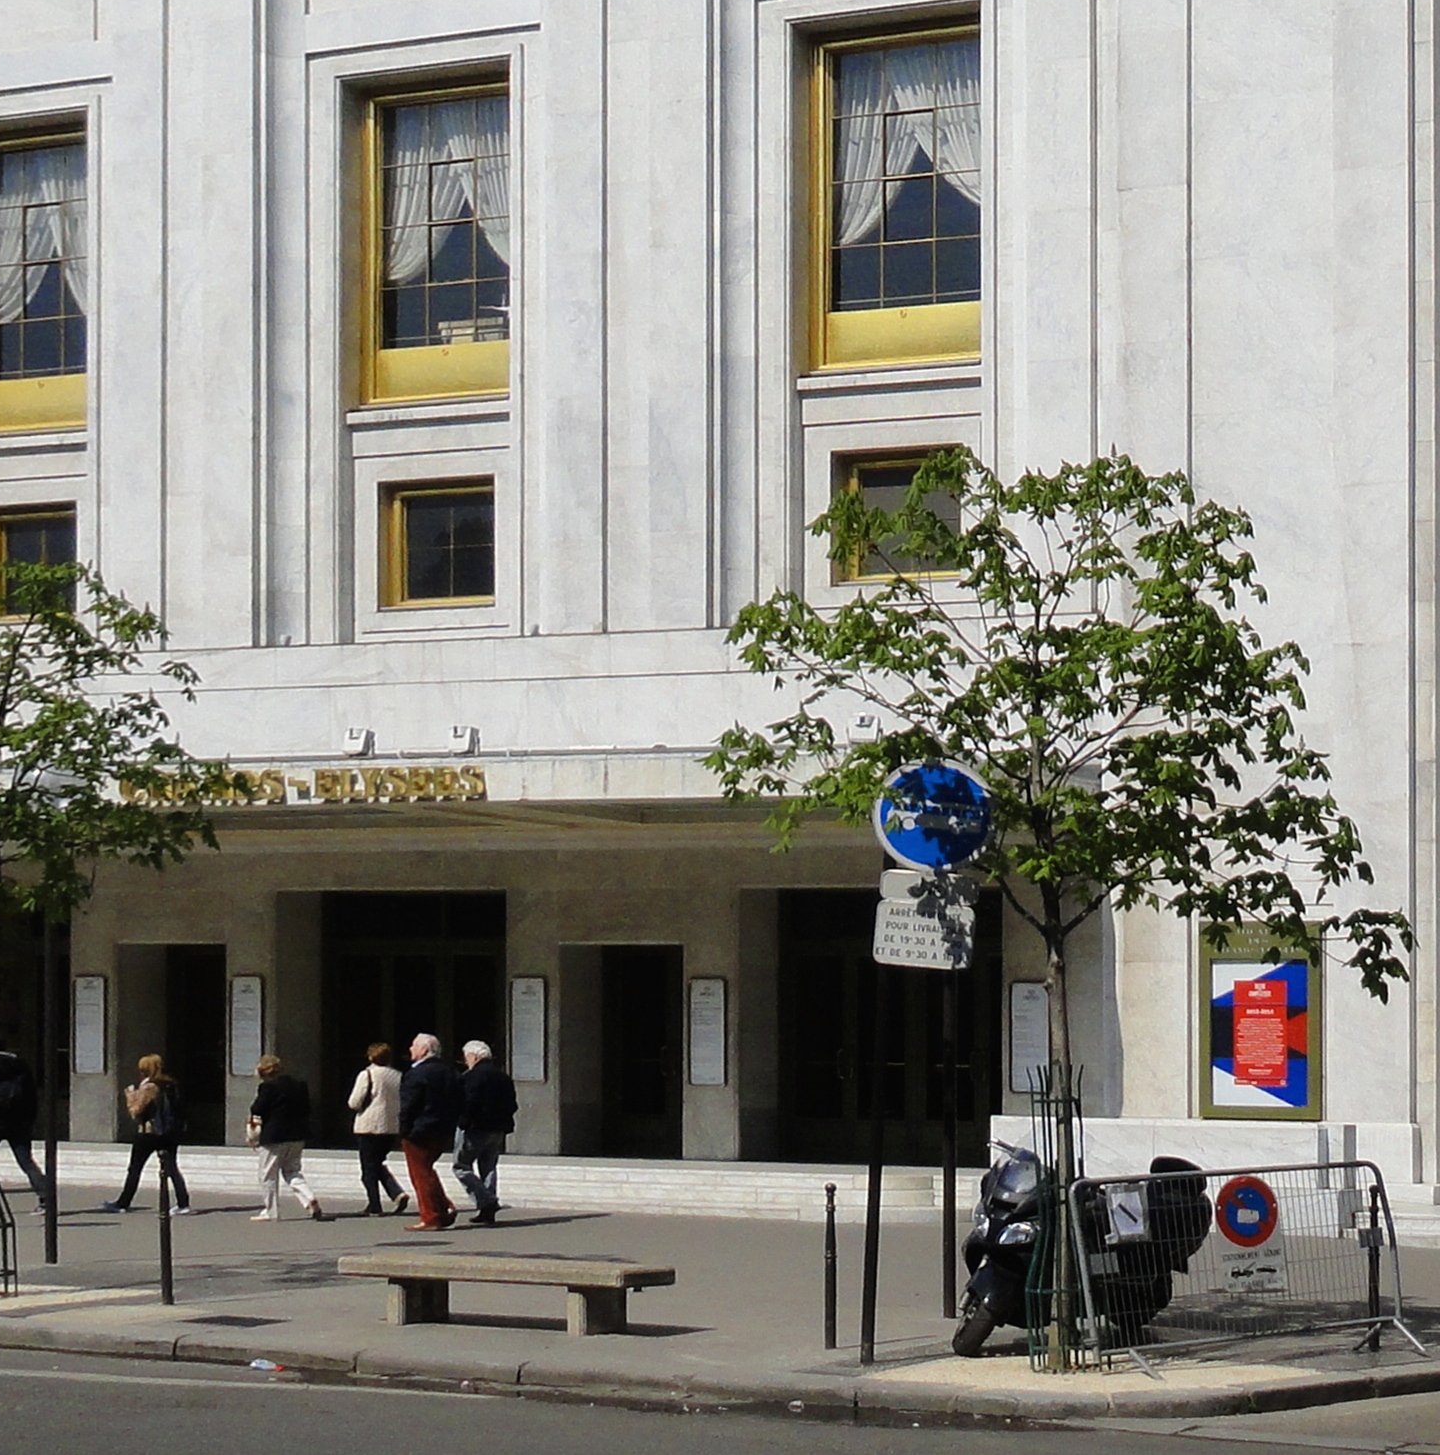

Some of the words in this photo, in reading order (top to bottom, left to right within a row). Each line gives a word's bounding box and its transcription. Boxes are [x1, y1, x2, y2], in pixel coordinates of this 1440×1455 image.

[885, 921, 909, 930] POUR
[883, 934, 895, 943] DE
[875, 947, 886, 955] ET
[889, 948, 901, 957] DE
